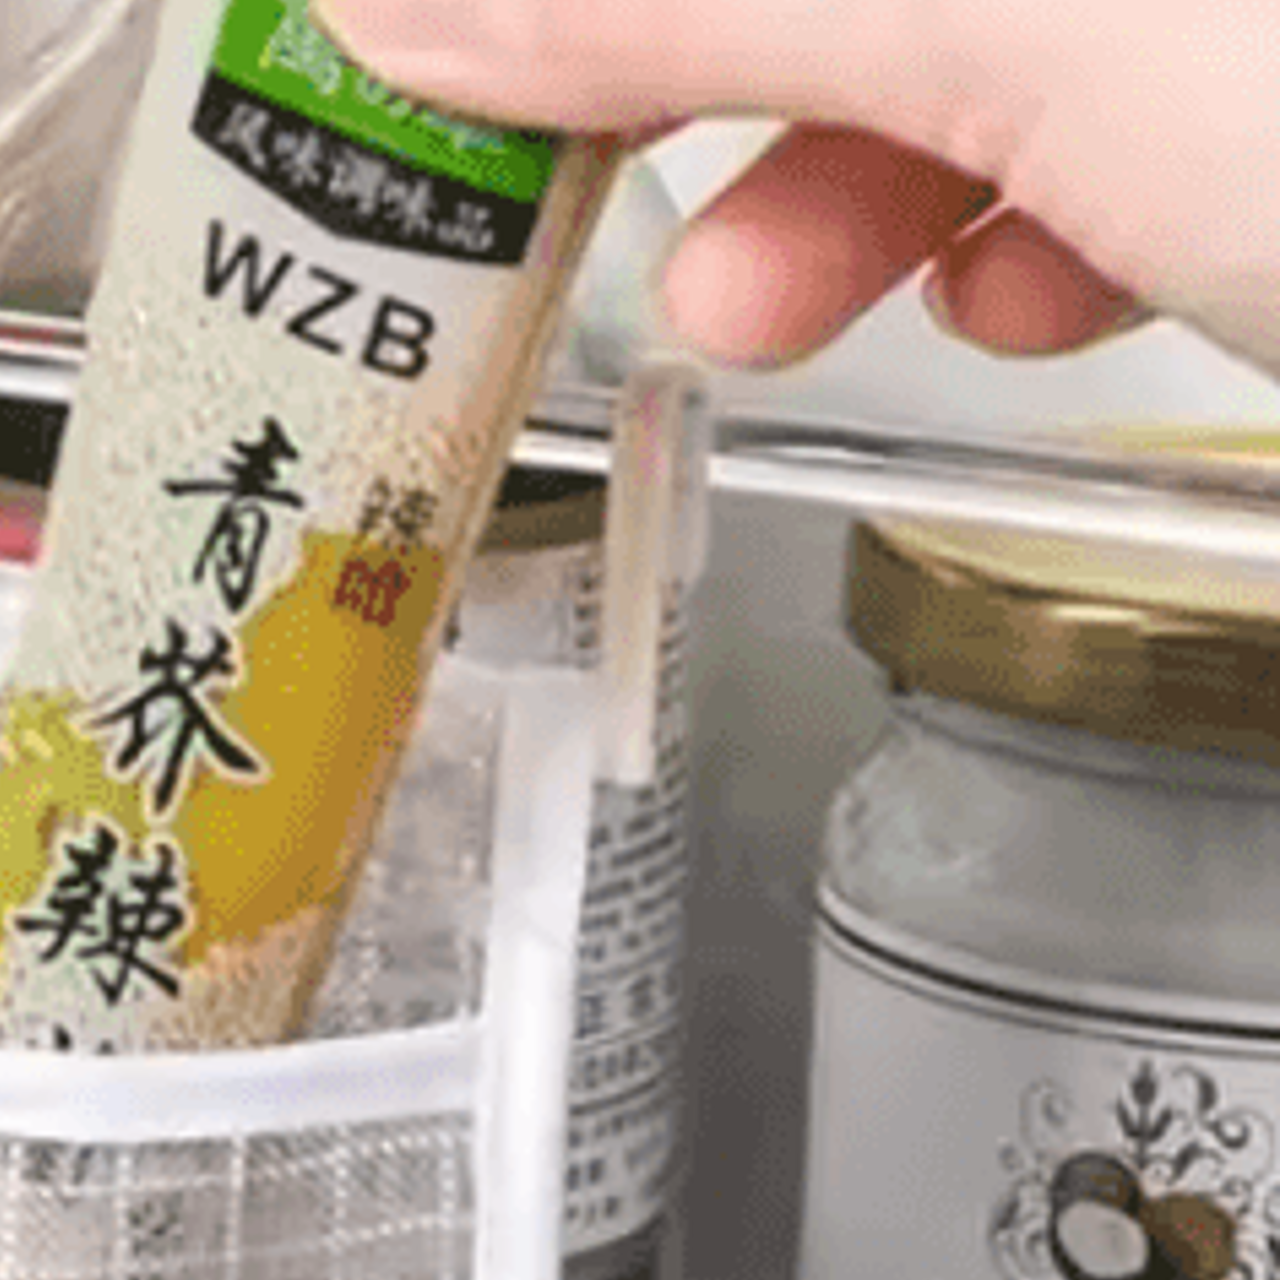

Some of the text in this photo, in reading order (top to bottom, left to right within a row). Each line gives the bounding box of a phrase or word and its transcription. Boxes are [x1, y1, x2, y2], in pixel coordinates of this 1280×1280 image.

[203, 218, 436, 381] WZB
[13, 414, 308, 1055] 青芥辣
